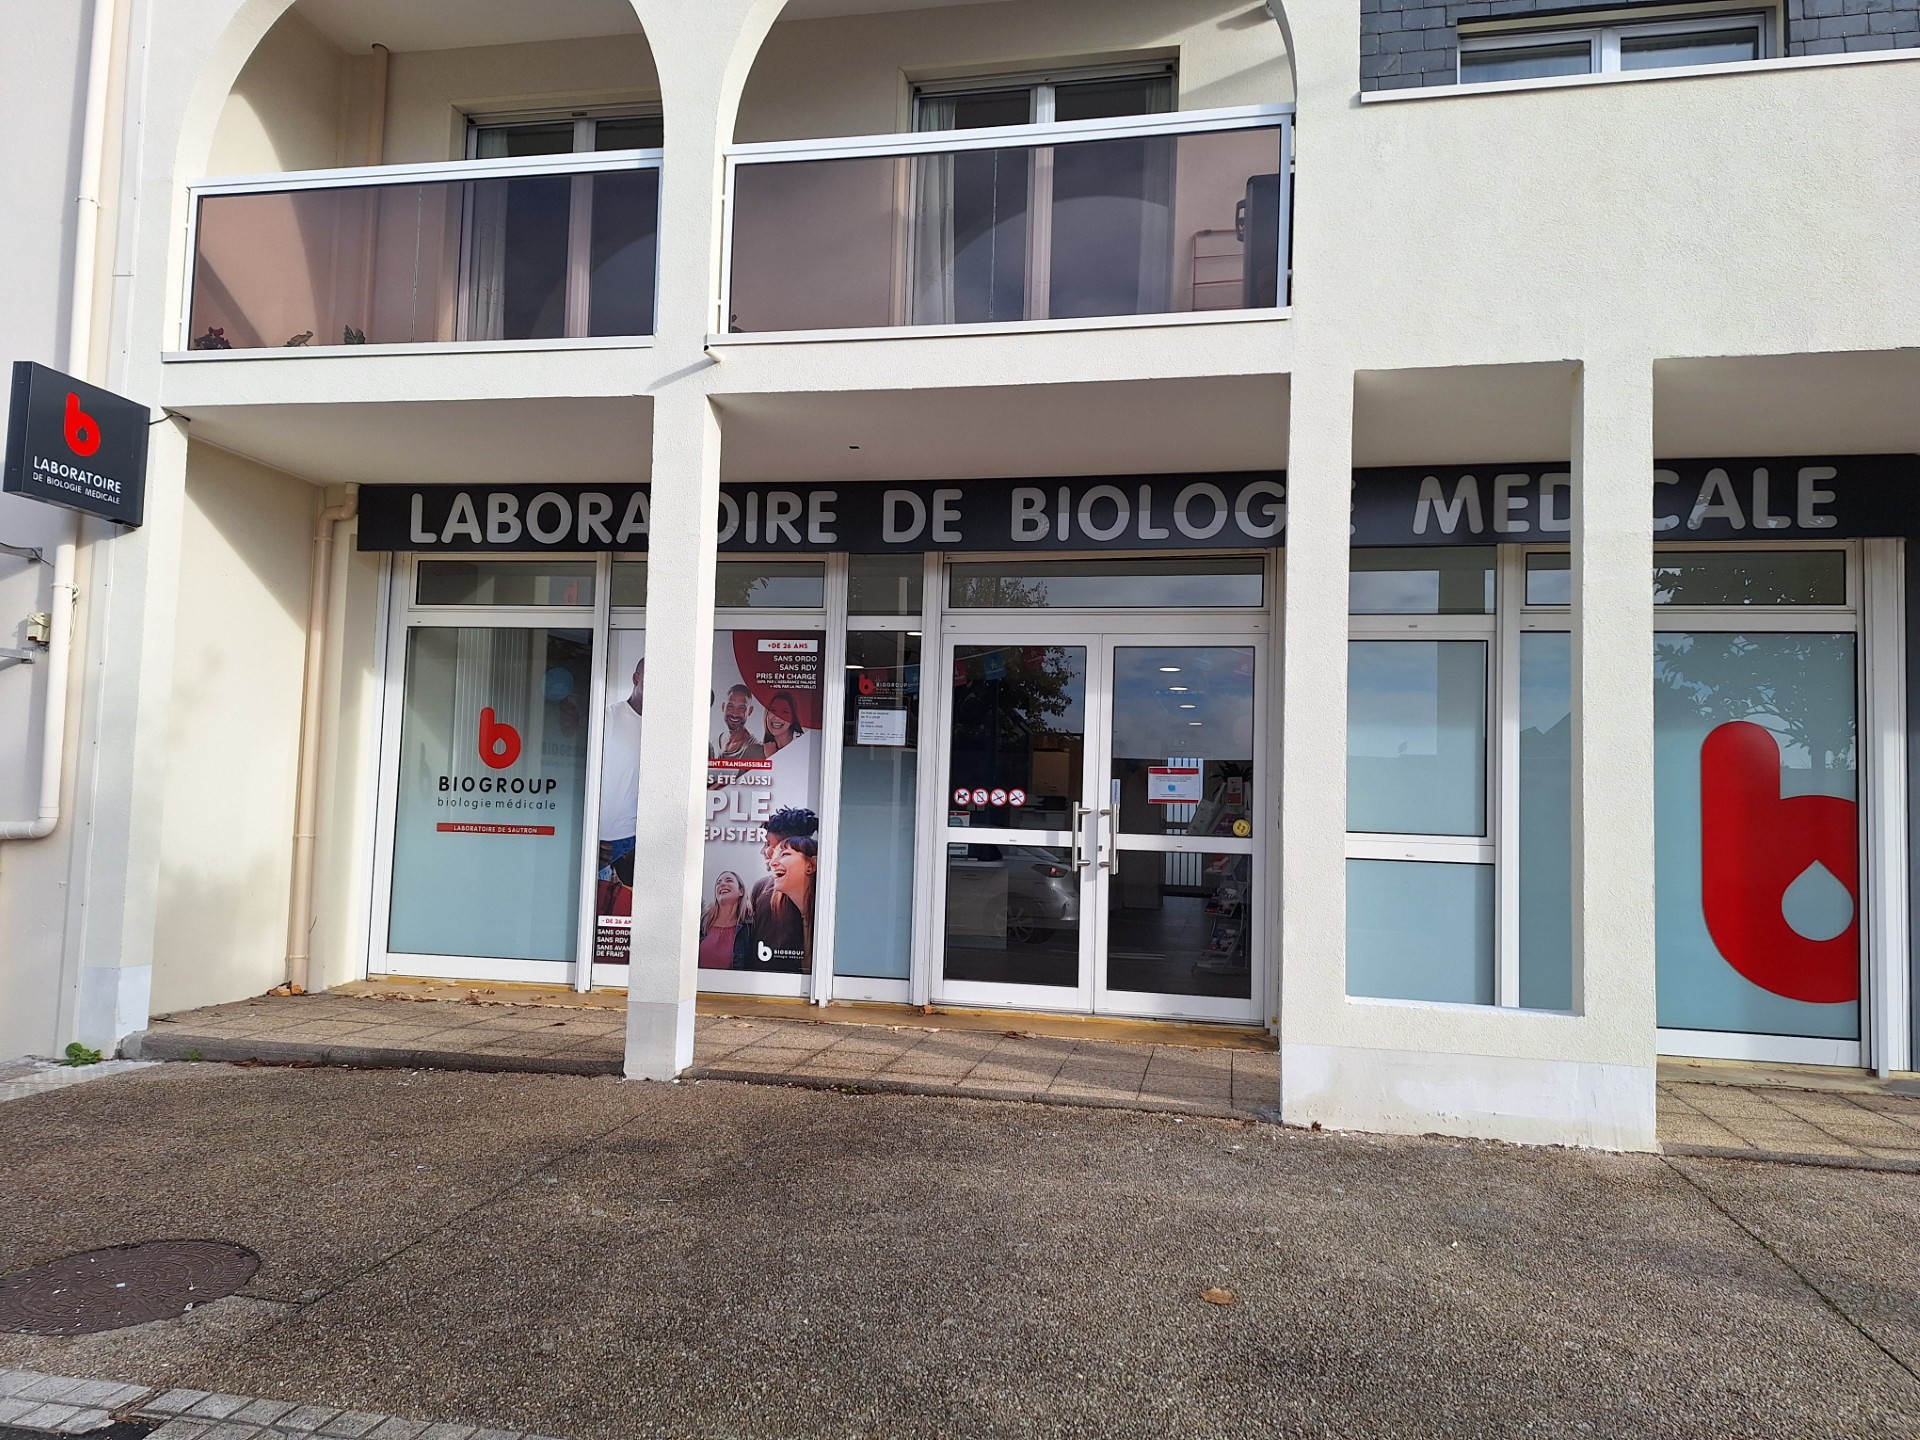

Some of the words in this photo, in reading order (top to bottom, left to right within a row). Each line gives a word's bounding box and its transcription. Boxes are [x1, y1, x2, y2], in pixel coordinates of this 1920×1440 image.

[33, 455, 122, 494] LABORATOIRE
[32, 471, 44, 483] DE
[46, 476, 82, 494] BIOLOGIE
[84, 488, 121, 505] MEDICALE
[882, 488, 963, 544] DE
[1010, 479, 1357, 543] BIOLOG
[438, 776, 557, 795] BIOGROUP
[717, 772, 737, 785] ÉTÉ
[739, 775, 772, 786] AUSSI
[437, 797, 492, 810] biologie
[495, 798, 556, 810] médicale
[453, 825, 496, 833] LABORATOIRE
[507, 826, 538, 834] SAUTRON
